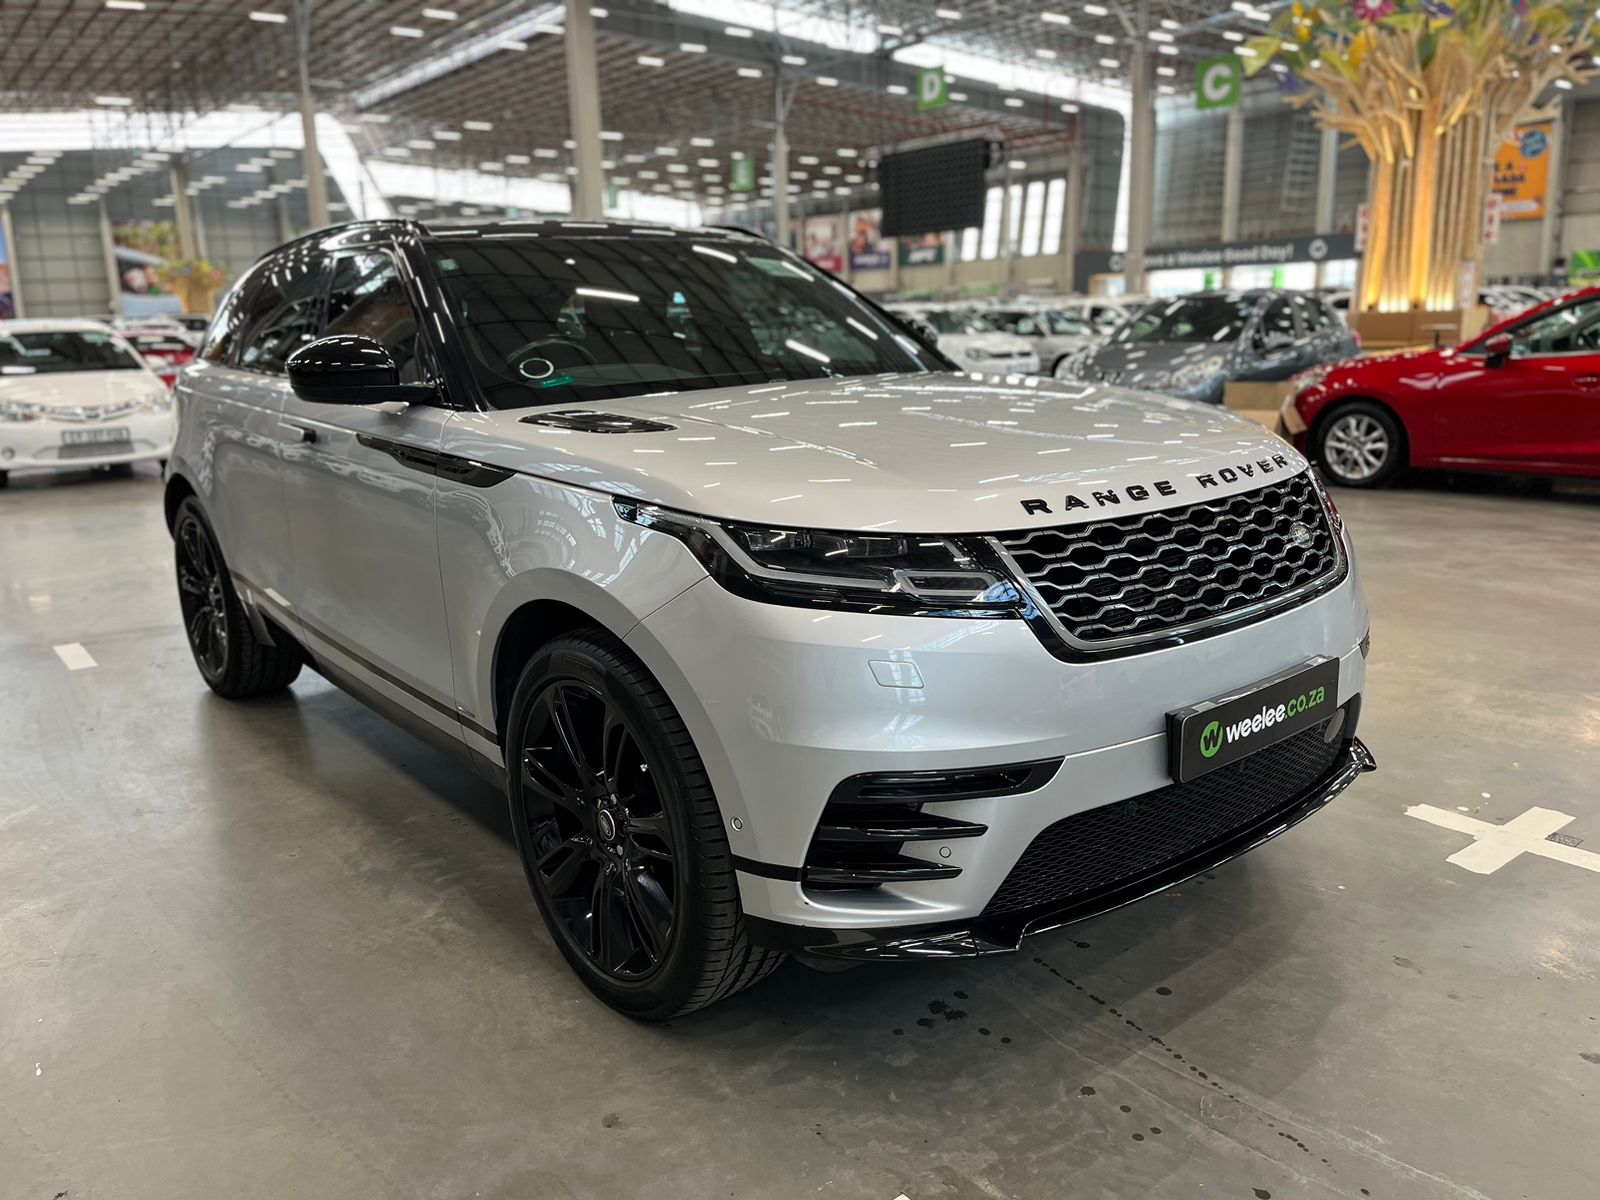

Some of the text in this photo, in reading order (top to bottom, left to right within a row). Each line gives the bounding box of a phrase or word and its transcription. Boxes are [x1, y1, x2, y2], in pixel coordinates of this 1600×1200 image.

[922, 72, 941, 102] D
[1203, 63, 1232, 101] C
[1223, 247, 1258, 263] Good
[1260, 243, 1294, 262] Day!
[1020, 453, 1288, 515] RANGE ROVER
[1225, 686, 1325, 744] weelee.co.za
